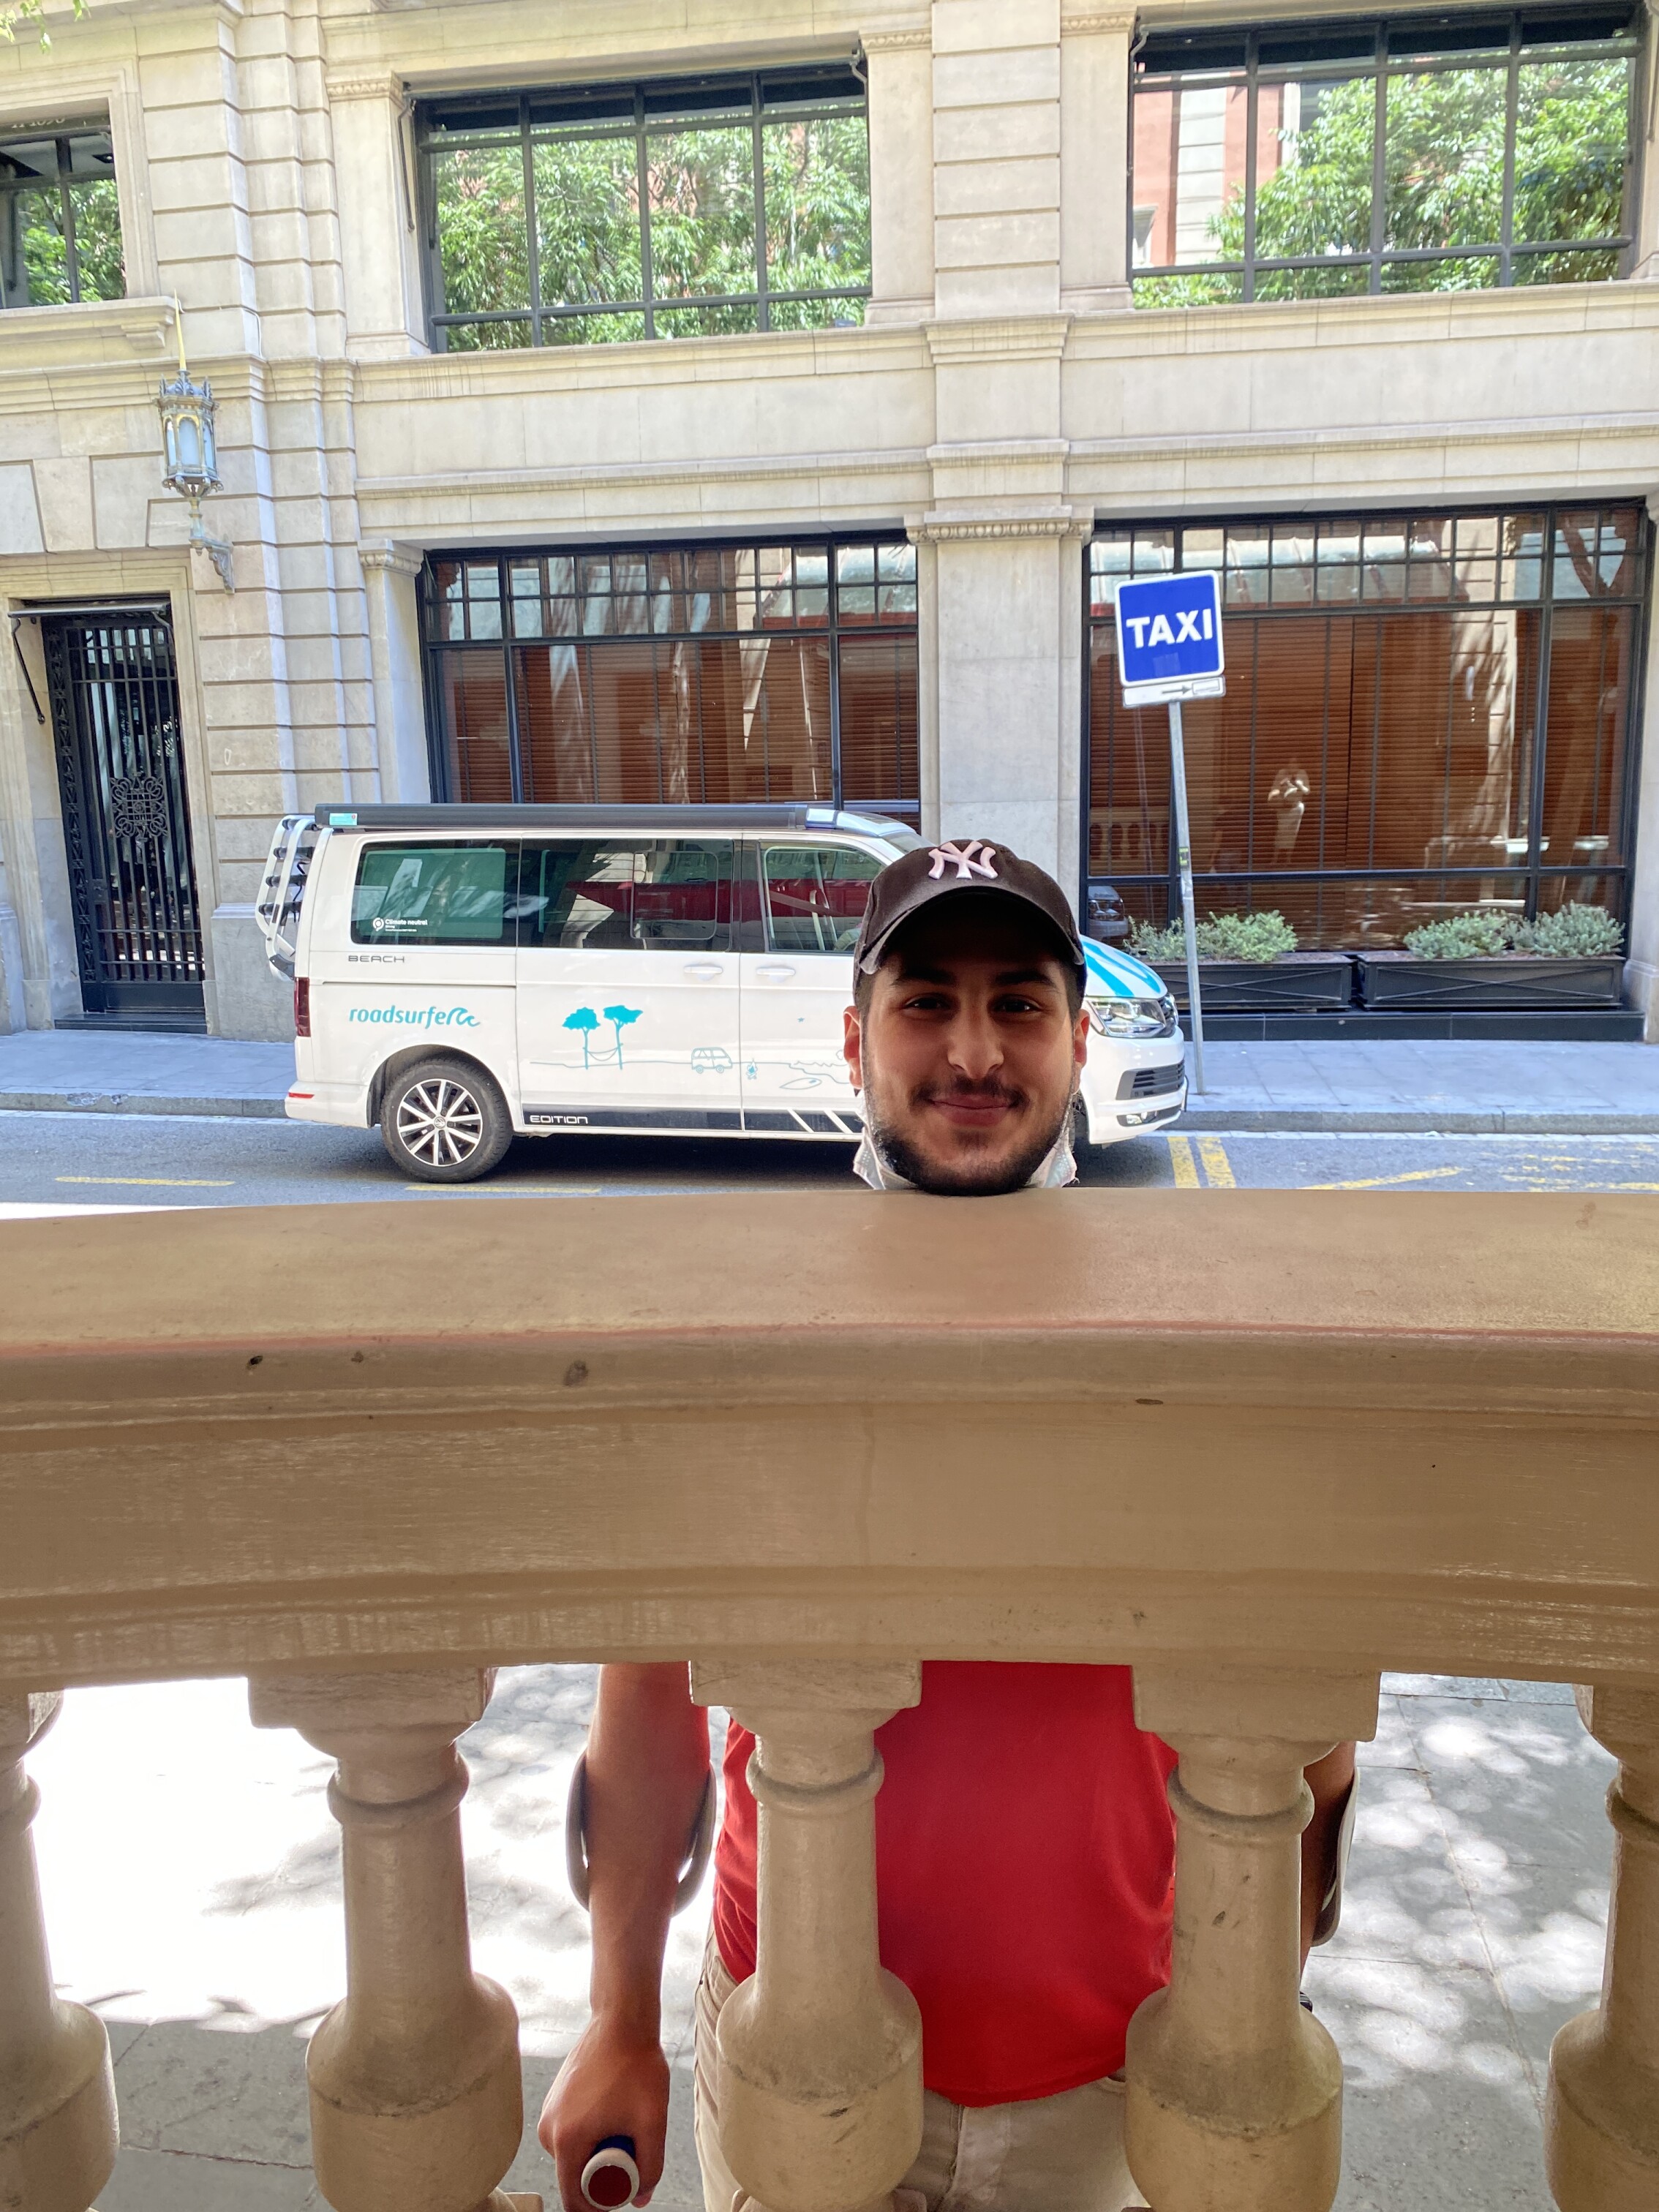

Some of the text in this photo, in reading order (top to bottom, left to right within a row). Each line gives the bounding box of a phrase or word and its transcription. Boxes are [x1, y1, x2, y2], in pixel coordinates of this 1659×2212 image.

[1126, 608, 1214, 649] TAXI
[928, 840, 998, 880] NY
[348, 955, 405, 963] BEACH
[348, 1004, 481, 1030] roadsurfer
[530, 1115, 589, 1124] EDITION
